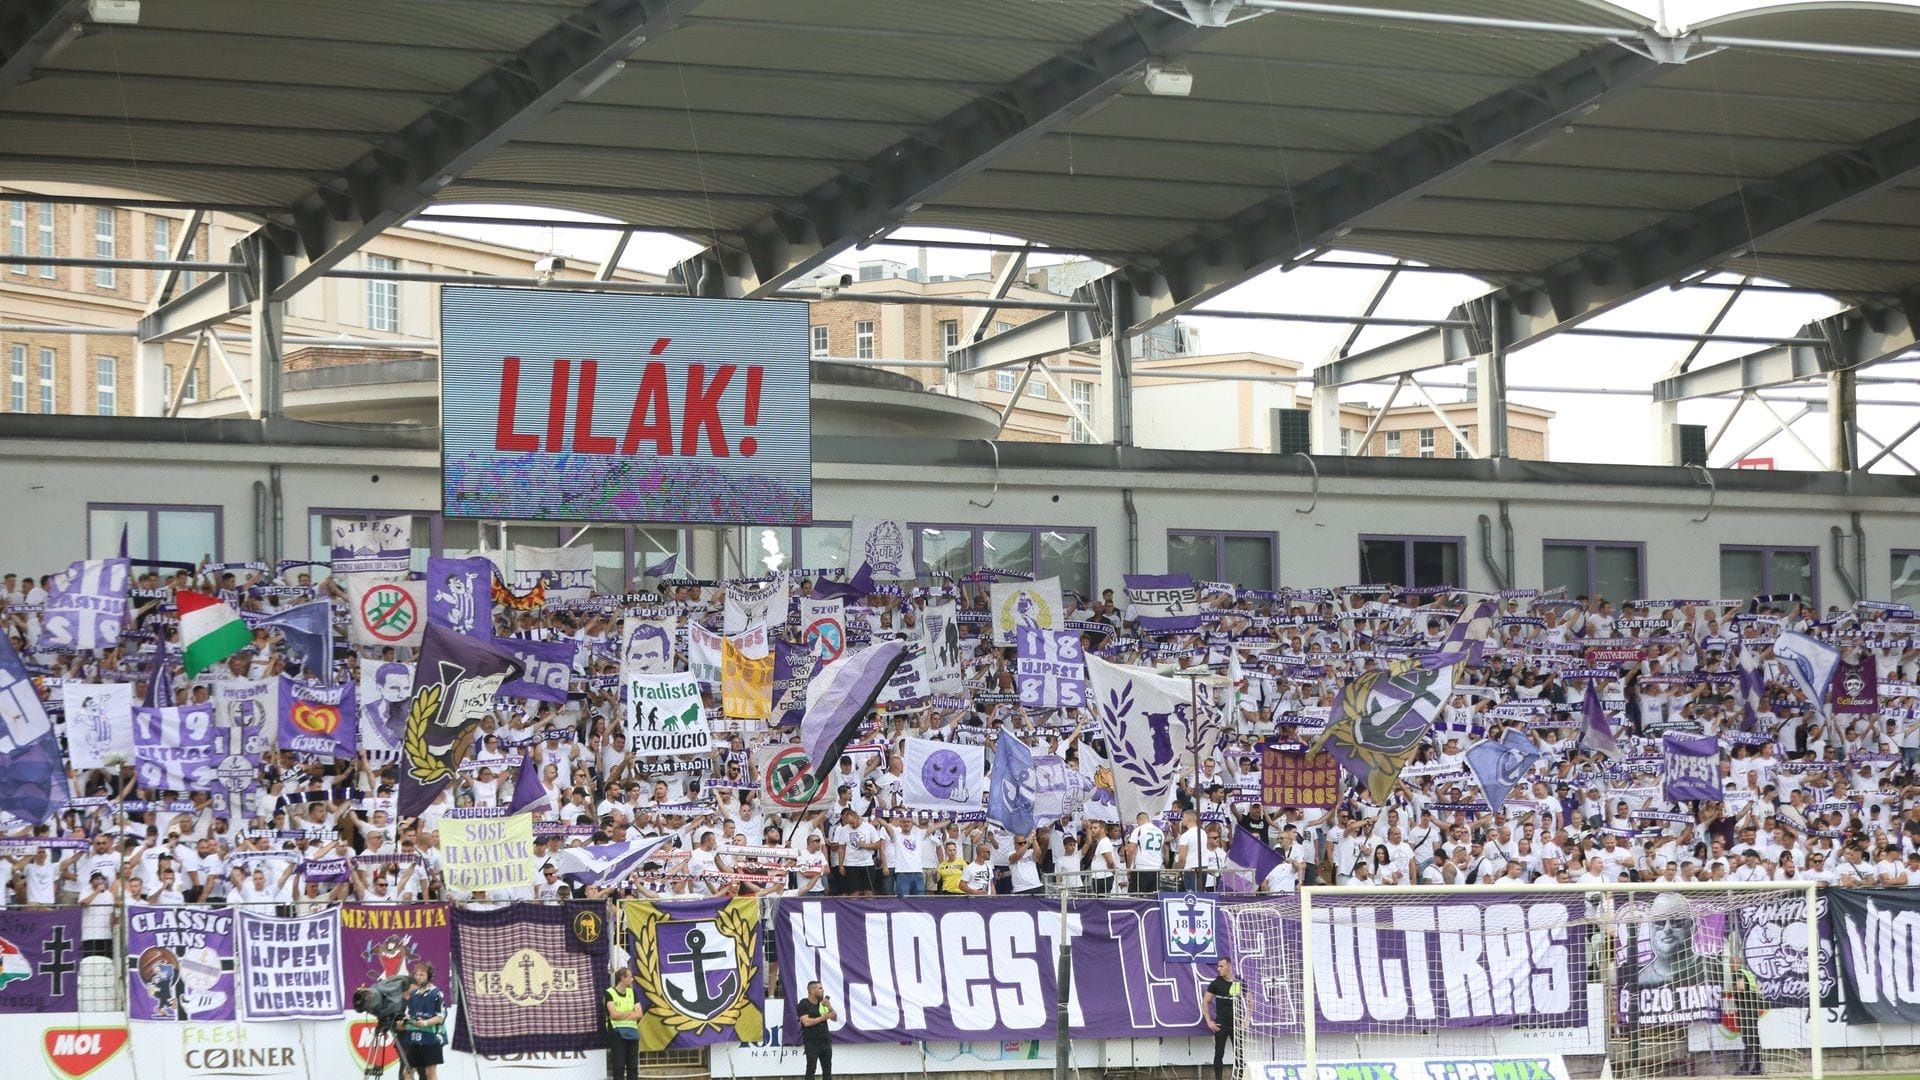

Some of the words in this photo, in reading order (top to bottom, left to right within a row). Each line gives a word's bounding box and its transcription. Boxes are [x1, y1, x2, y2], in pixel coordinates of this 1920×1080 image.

[495, 337, 763, 457] LILÁK!
[627, 594, 658, 602] FRADI
[1130, 589, 1194, 603] ULTRAS
[811, 605, 839, 614] STOP
[1617, 620, 1641, 628] SZAR
[1643, 620, 1669, 628] FRADI
[1021, 660, 1079, 679] ÚJPEST
[632, 680, 698, 700] fradista
[632, 729, 708, 750] EVOLÚCIÓ
[642, 763, 672, 773] SZAR
[674, 760, 707, 772] FRADI
[1263, 770, 1296, 787] UTE
[1297, 770, 1337, 787] 1885
[1263, 787, 1295, 805] UTE
[1297, 787, 1337, 805] 1885
[465, 821, 506, 842] SOSE
[1145, 832, 1164, 851] 23
[445, 841, 529, 865] HAGYUNK
[449, 863, 528, 886] EGYEDÜL
[131, 910, 233, 936] CLASSIC
[247, 921, 301, 941] CSAK
[307, 919, 330, 939] AZ
[1174, 919, 1189, 929] 18
[1195, 919, 1209, 929] 85
[155, 932, 206, 949] FANS
[789, 902, 1085, 1031] ÚJPEST
[1312, 903, 1571, 1021] ULTRAS
[253, 972, 269, 987] AD
[479, 971, 502, 994] 18
[53, 1033, 103, 1056] MOL
[411, 1032, 422, 1041] 18
